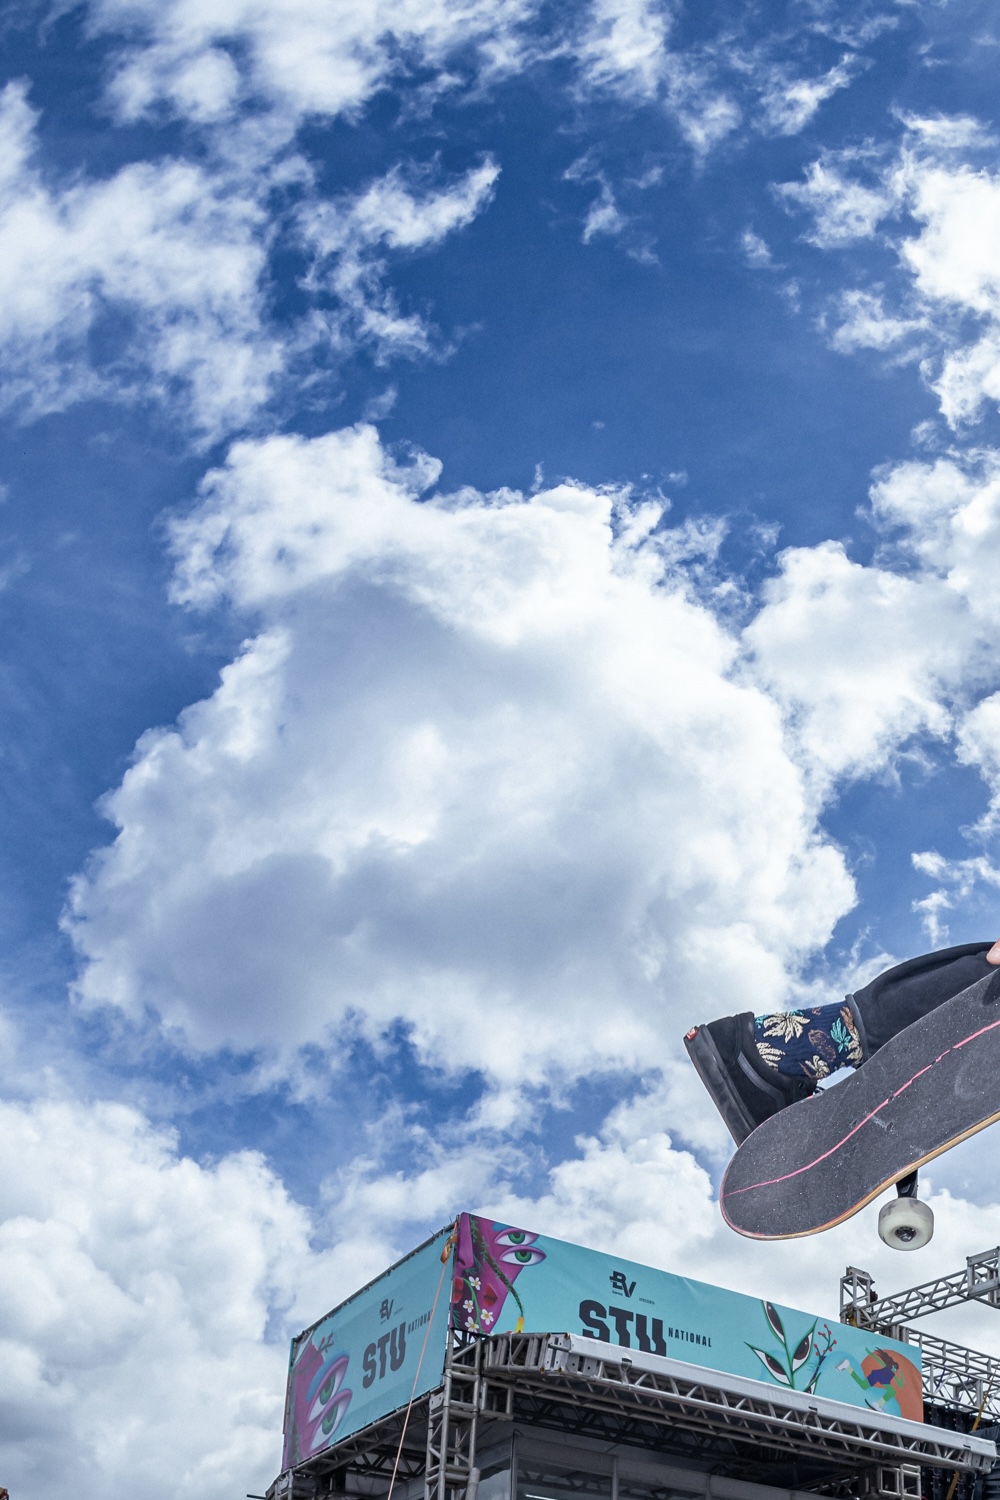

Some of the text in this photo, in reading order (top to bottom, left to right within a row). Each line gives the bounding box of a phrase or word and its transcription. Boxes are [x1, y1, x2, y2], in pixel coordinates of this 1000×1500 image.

[362, 1322, 406, 1389] STU
[579, 1299, 712, 1357] STU NATIONAL
